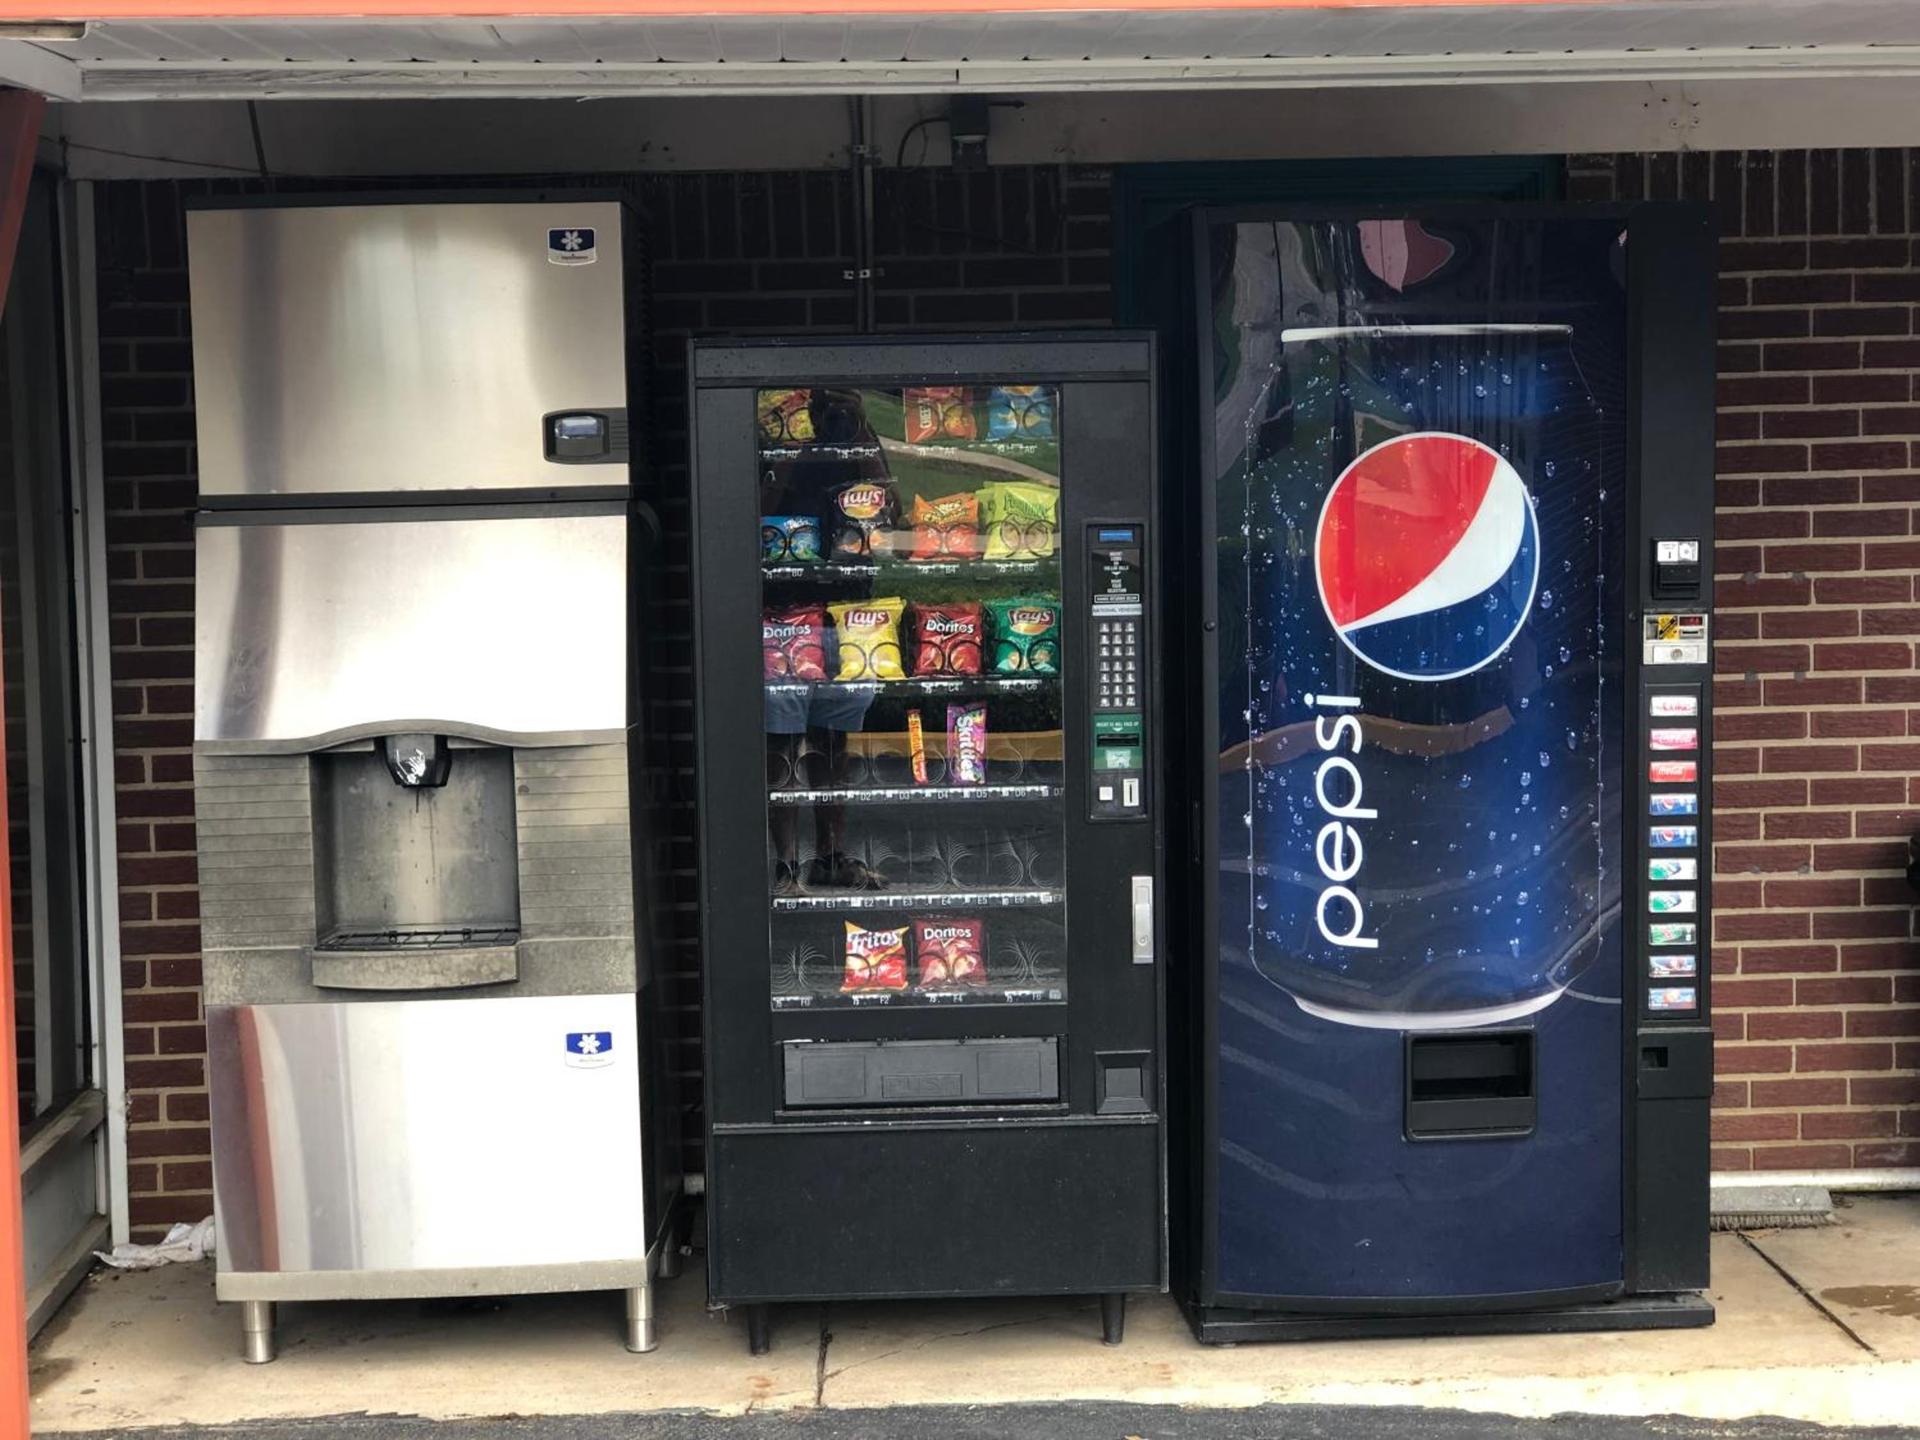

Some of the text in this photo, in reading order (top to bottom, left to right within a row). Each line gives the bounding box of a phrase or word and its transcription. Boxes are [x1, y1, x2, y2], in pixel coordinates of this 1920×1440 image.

[926, 618, 974, 634] Doritos
[762, 624, 811, 639] Doritos
[872, 685, 884, 694] C2
[957, 715, 976, 781] Skittles
[861, 791, 871, 801] D2
[899, 791, 910, 800] D3
[938, 790, 949, 799] D4
[976, 789, 987, 798] D5
[1304, 692, 1379, 949] pepsi
[786, 900, 797, 909] E0
[826, 900, 836, 909] E1
[863, 899, 874, 908] E2
[903, 898, 913, 907] E3
[941, 896, 952, 905] E4
[977, 896, 988, 905] E5
[923, 927, 973, 940] Doritos
[846, 930, 900, 954] Fritos
[880, 995, 890, 1005] F2
